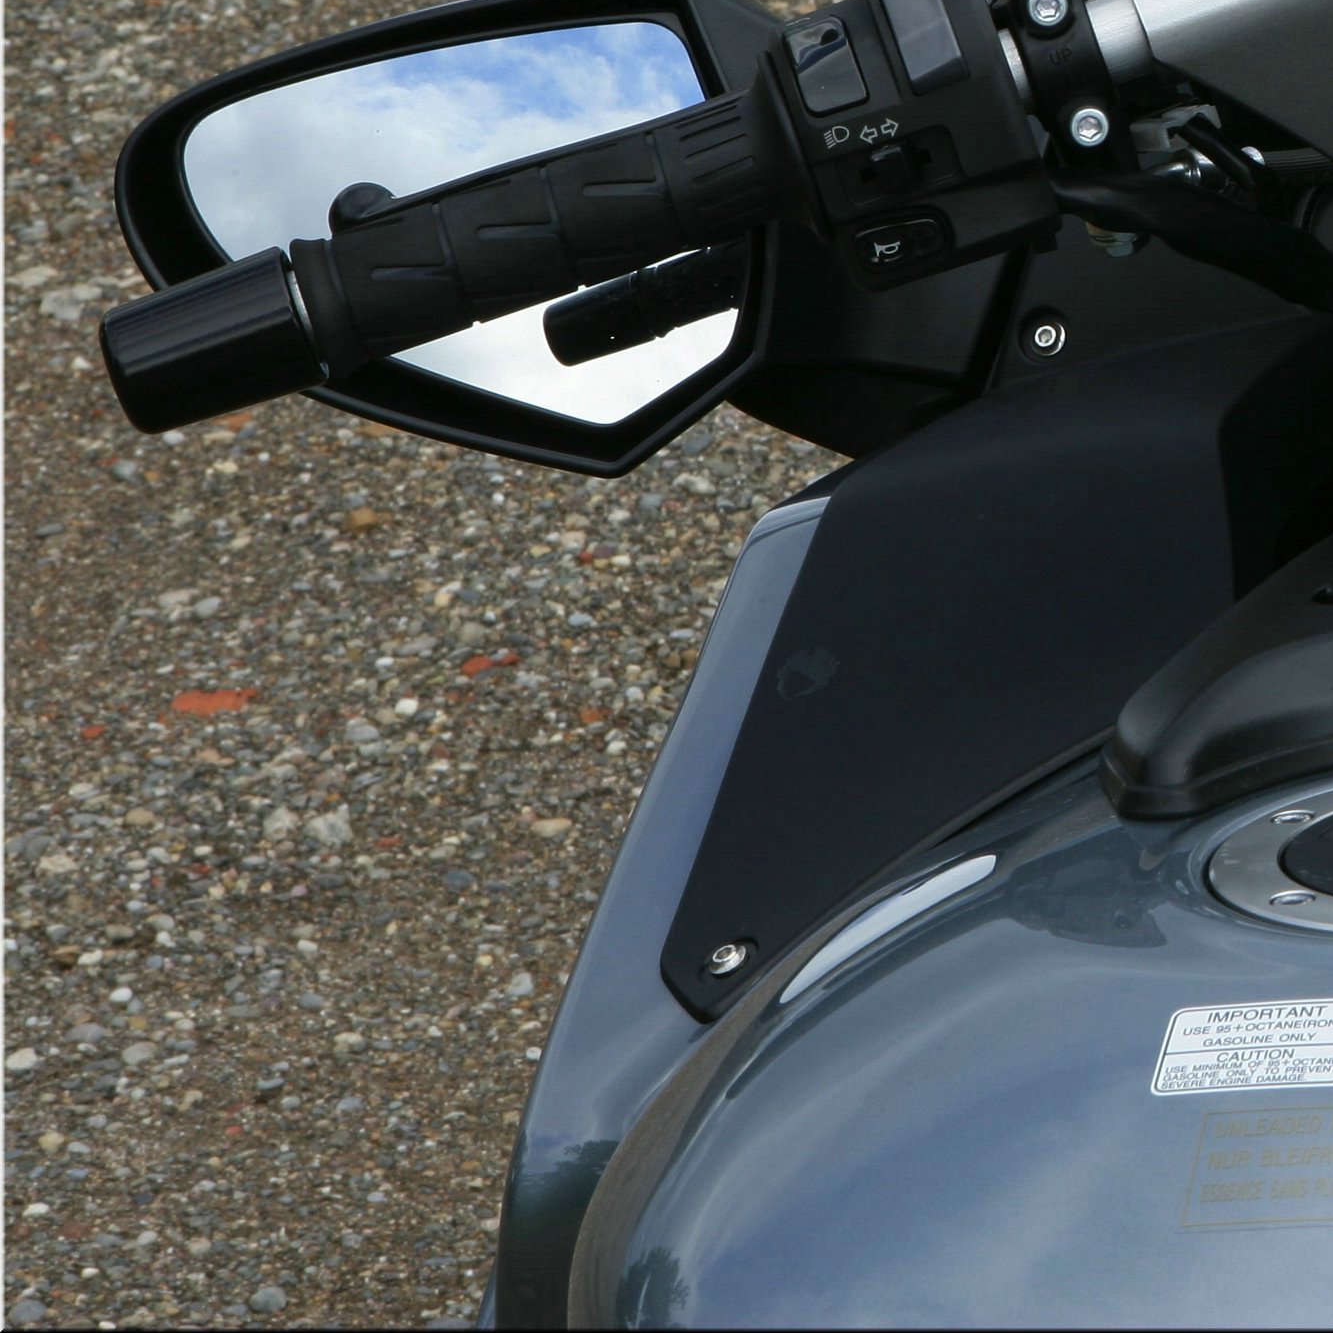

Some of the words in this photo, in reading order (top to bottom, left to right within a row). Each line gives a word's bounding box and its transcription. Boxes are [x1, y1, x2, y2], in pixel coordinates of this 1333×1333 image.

[1048, 48, 1073, 66] UP
[1206, 1005, 1328, 1024] IMPORTANT
[1182, 1025, 1212, 1037] USE
[1202, 1034, 1274, 1047] GASOLINE
[1278, 1032, 1317, 1043] ONLY
[1215, 1048, 1296, 1063] CAUTION
[1162, 1069, 1220, 1082] GASOLINE
[1225, 1067, 1257, 1078] ONLY
[1264, 1066, 1280, 1075] TO
[1165, 1065, 1186, 1075] USE
[1191, 1061, 1243, 1073] MINIMUM
[1247, 1060, 1264, 1069] OF
[1161, 1078, 1206, 1090] SEVERE
[1209, 1076, 1254, 1087] ENGINE
[1214, 1116, 1323, 1139] UNLEADED
